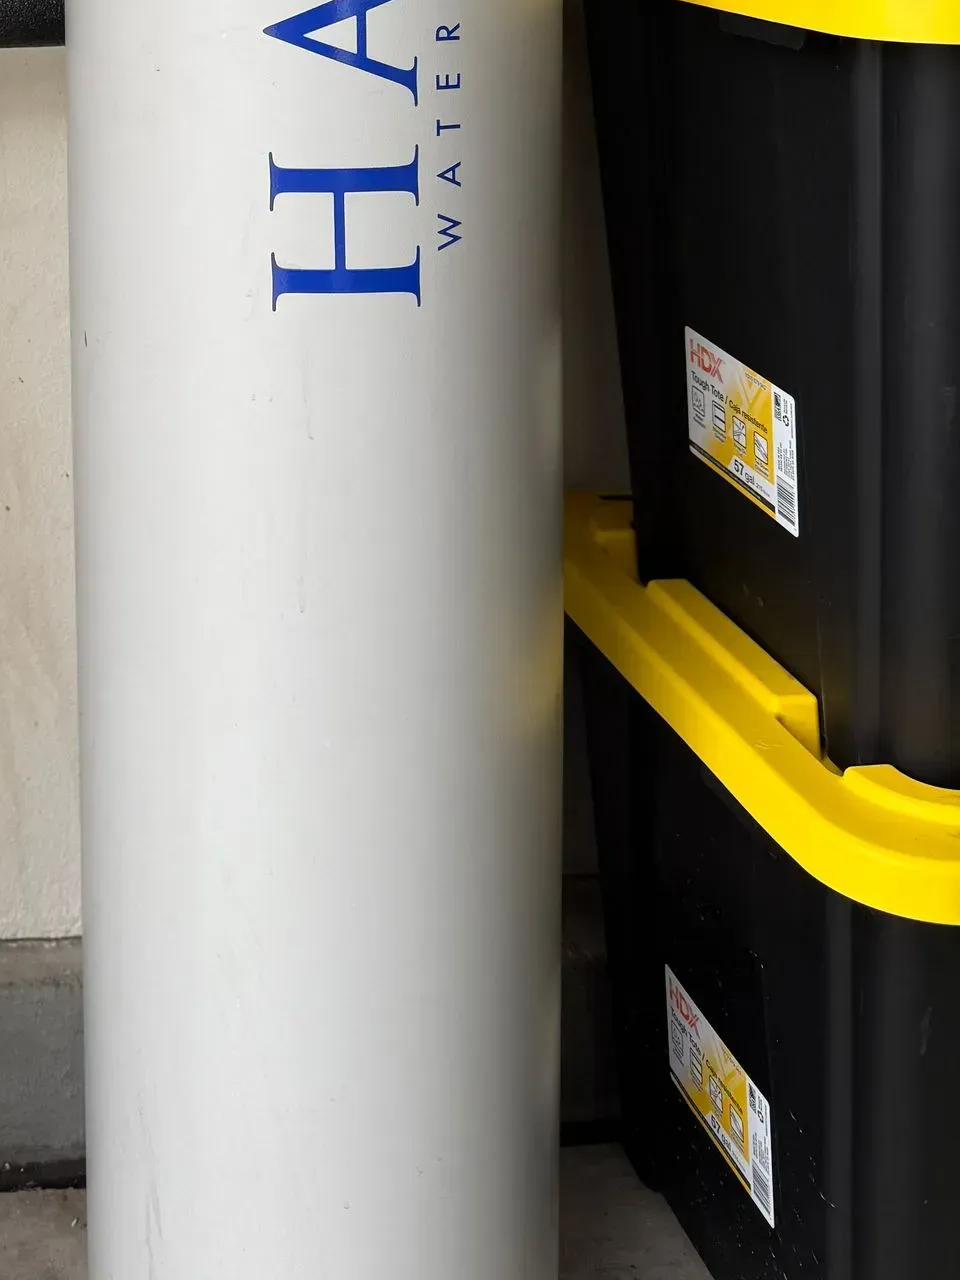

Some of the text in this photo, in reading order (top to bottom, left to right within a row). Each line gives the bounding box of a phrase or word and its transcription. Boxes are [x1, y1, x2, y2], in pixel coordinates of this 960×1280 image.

[434, 23, 462, 251] WATER
[689, 338, 724, 384] HDX
[690, 370, 710, 392] Tough
[710, 384, 725, 402] Tote
[733, 458, 745, 476] 57
[744, 472, 755, 484] gal
[669, 977, 701, 1040] HDX
[710, 1114, 721, 1134] 57
